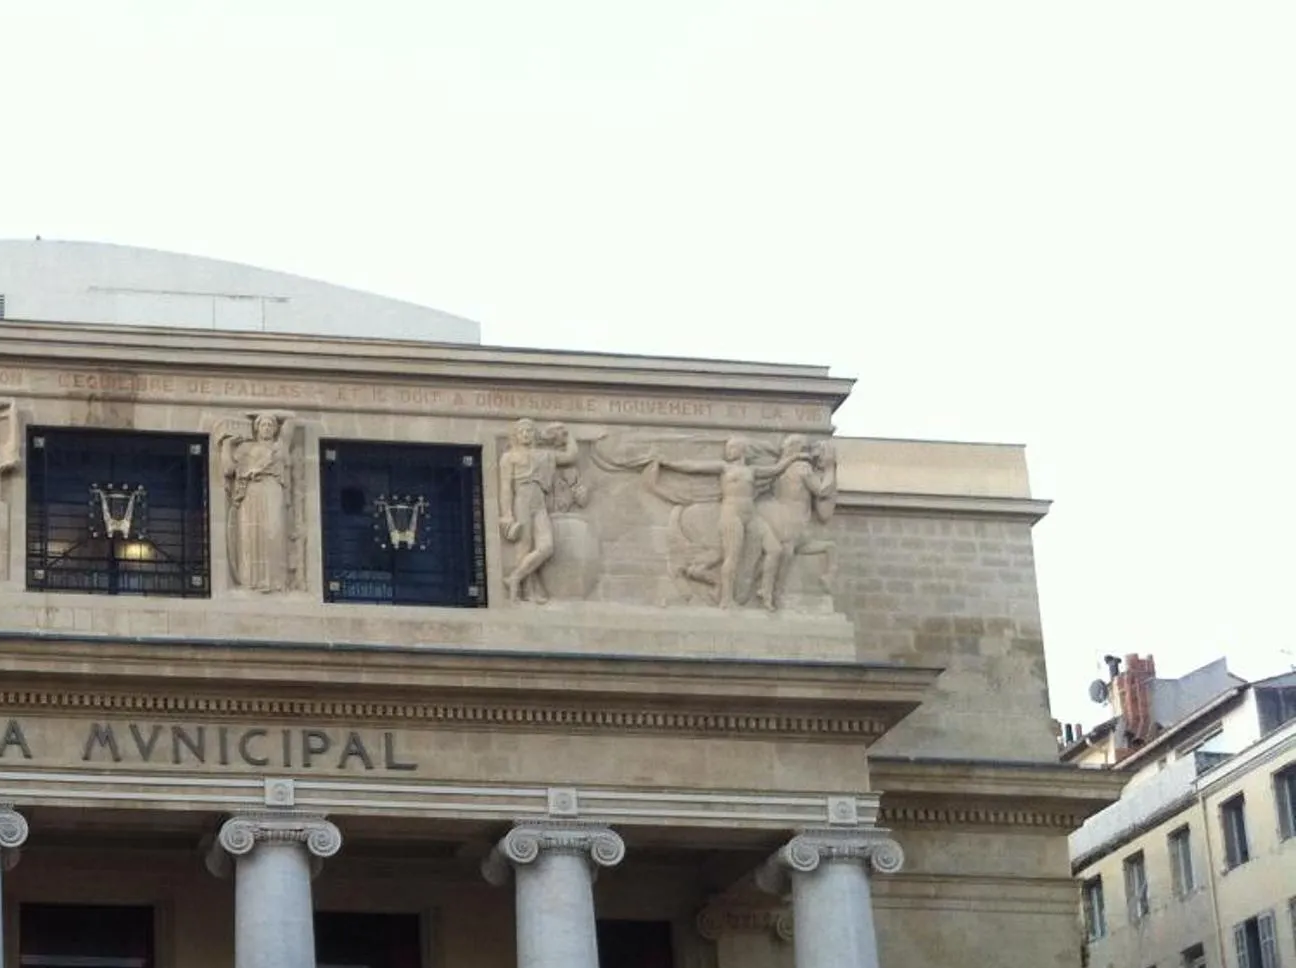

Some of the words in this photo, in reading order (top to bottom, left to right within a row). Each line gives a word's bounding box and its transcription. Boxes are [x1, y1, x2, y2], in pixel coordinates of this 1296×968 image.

[224, 379, 303, 398] PALLAS
[609, 398, 713, 417] MOUVEMENT
[82, 722, 419, 772] MVNICIPAL
